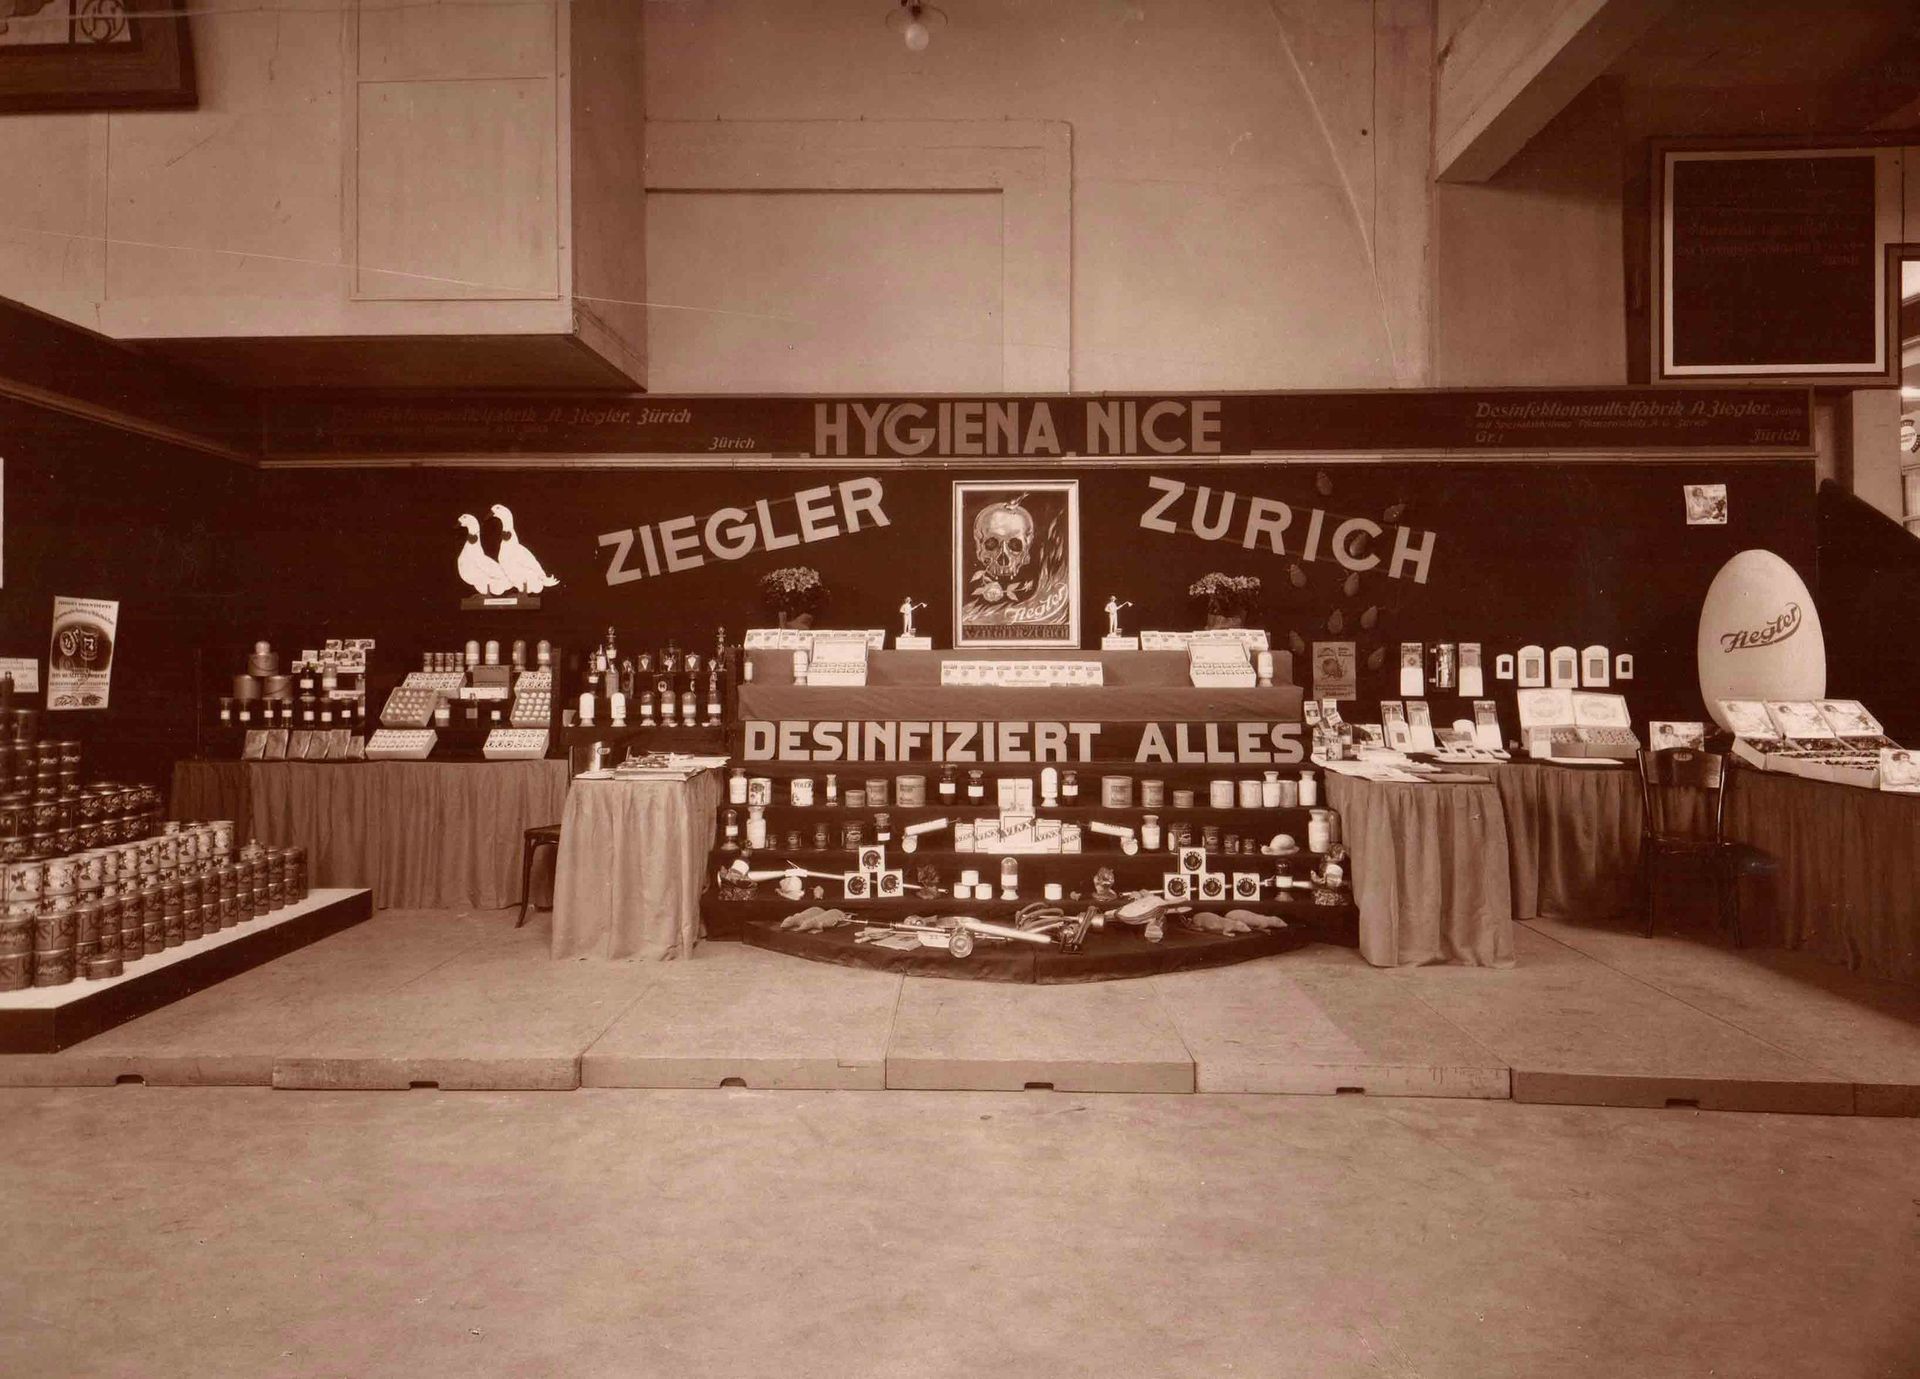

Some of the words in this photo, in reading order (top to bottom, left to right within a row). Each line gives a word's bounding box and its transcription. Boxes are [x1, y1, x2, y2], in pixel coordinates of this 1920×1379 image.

[637, 407, 691, 425] Zürich
[814, 402, 1062, 456] HYGIENA
[1086, 400, 1222, 455] NICE
[709, 436, 756, 450] Zürich
[598, 477, 891, 586] ZIEGLER
[1139, 476, 1437, 584] ZURICH
[744, 720, 1101, 762] DESINFIZIERT
[1134, 721, 1304, 763] ALLES
